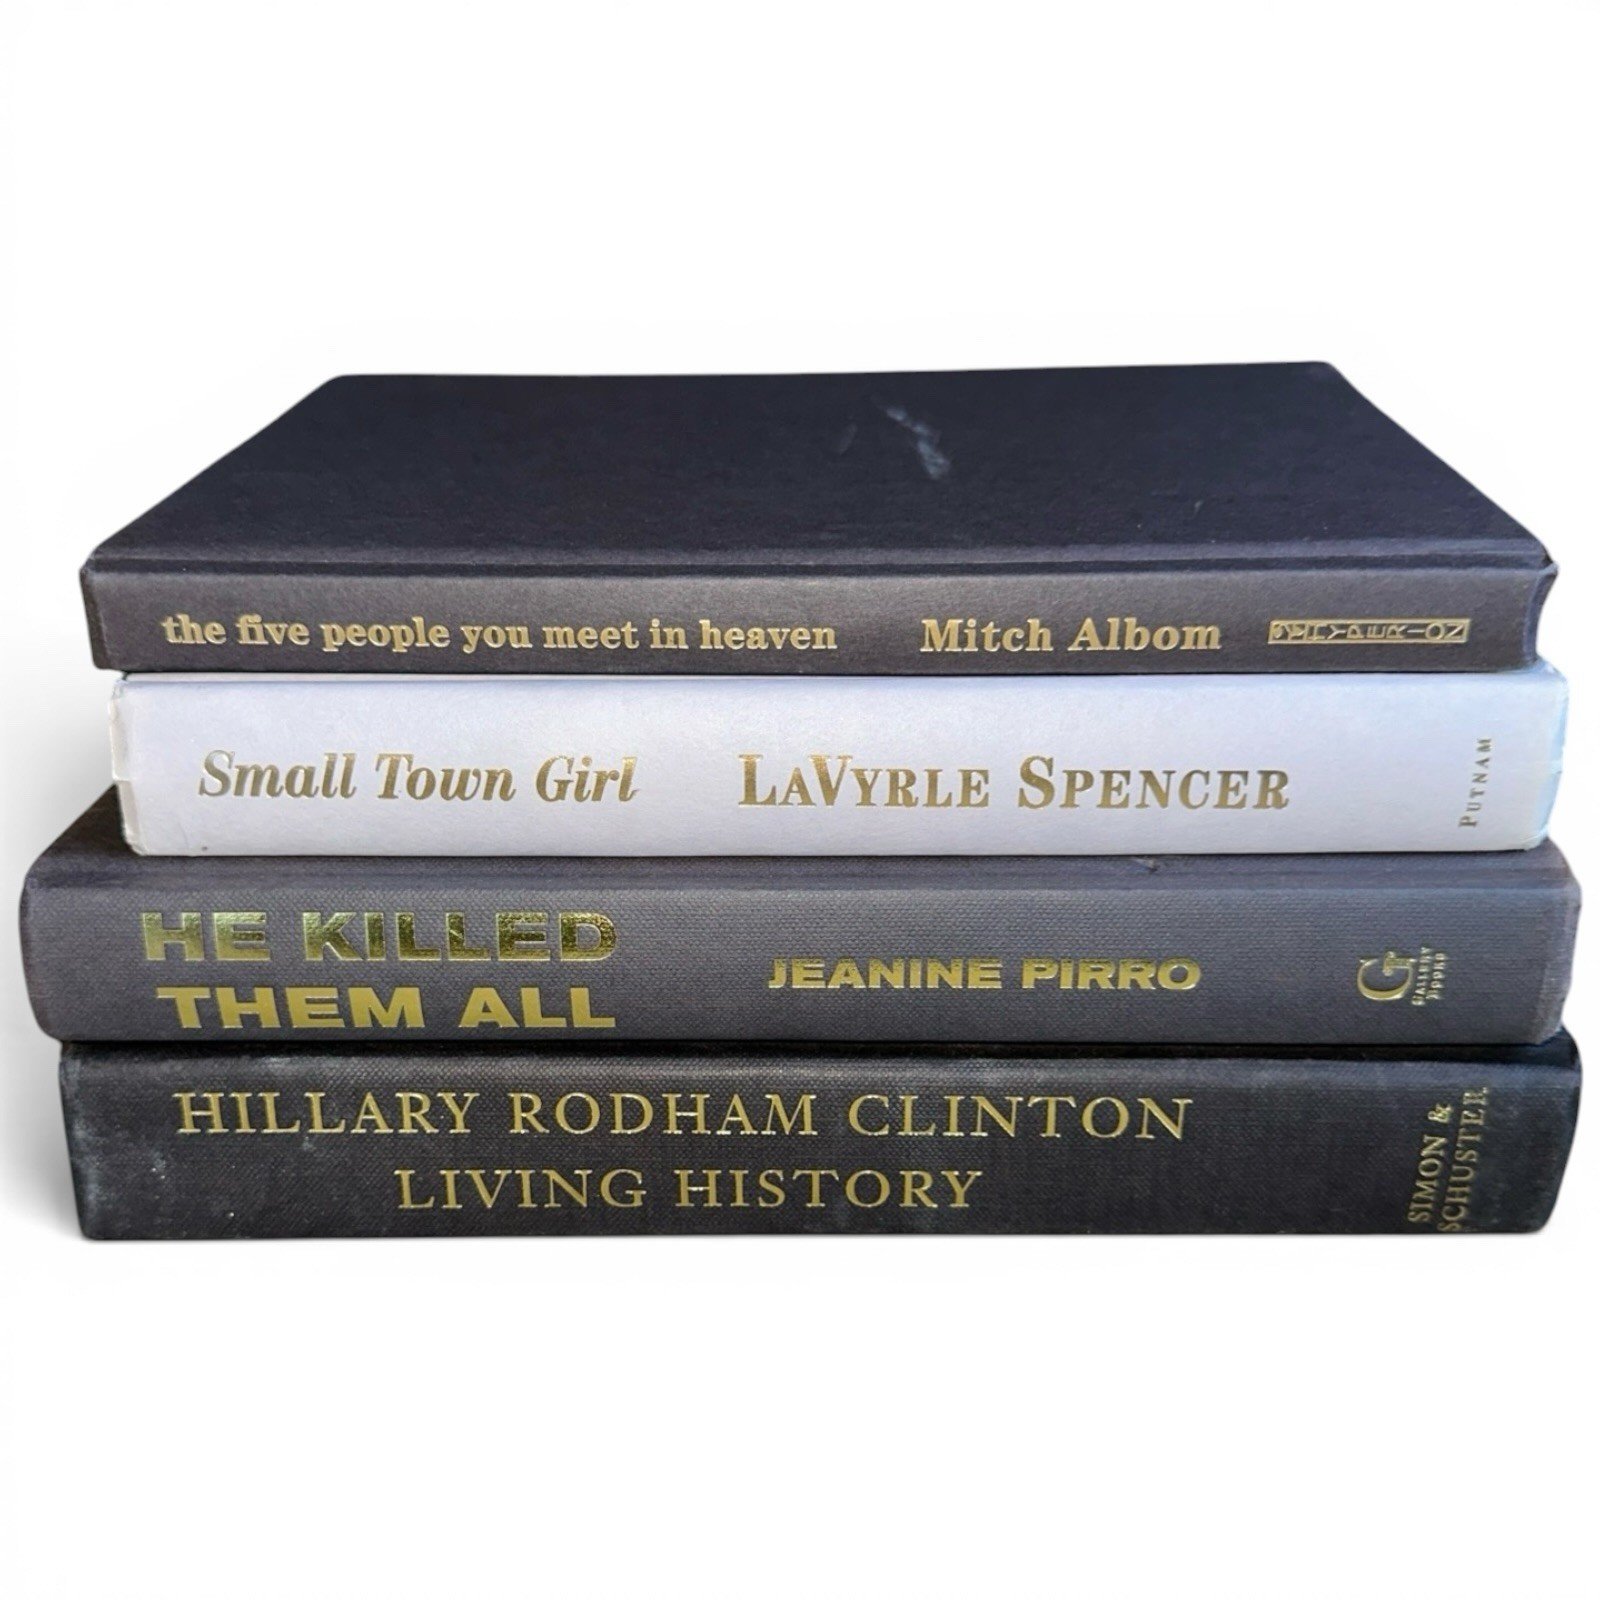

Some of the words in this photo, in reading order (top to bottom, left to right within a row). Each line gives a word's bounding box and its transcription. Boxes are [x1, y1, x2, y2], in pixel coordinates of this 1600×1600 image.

[162, 614, 226, 646] the
[237, 615, 310, 645] five
[323, 616, 448, 651] people
[462, 621, 532, 653] you
[543, 621, 638, 649] meet
[650, 619, 679, 650] in
[699, 619, 837, 650] heaven
[920, 617, 1053, 653] Mitch
[1068, 616, 1221, 652] Albom
[1307, 622, 1465, 641] HYPERION
[198, 750, 357, 800] Small
[373, 752, 517, 802] Town
[535, 756, 639, 804] Girl
[140, 911, 271, 962] HE
[302, 911, 617, 962] KILLED
[768, 958, 1003, 989] JEANINE
[1021, 959, 1201, 991] PIRRO
[157, 985, 426, 1029] THEM
[459, 985, 616, 1029] ALL
[174, 1092, 477, 1135] HILLARY
[509, 1093, 819, 1137] RODHAM
[847, 1094, 1193, 1140] CLINTON
[1427, 1103, 1453, 1123] &
[1407, 1135, 1448, 1223] SIMON
[1437, 1087, 1488, 1232] SCHUSTER
[393, 1168, 646, 1210] LIVING
[674, 1169, 983, 1210] HISTORY
